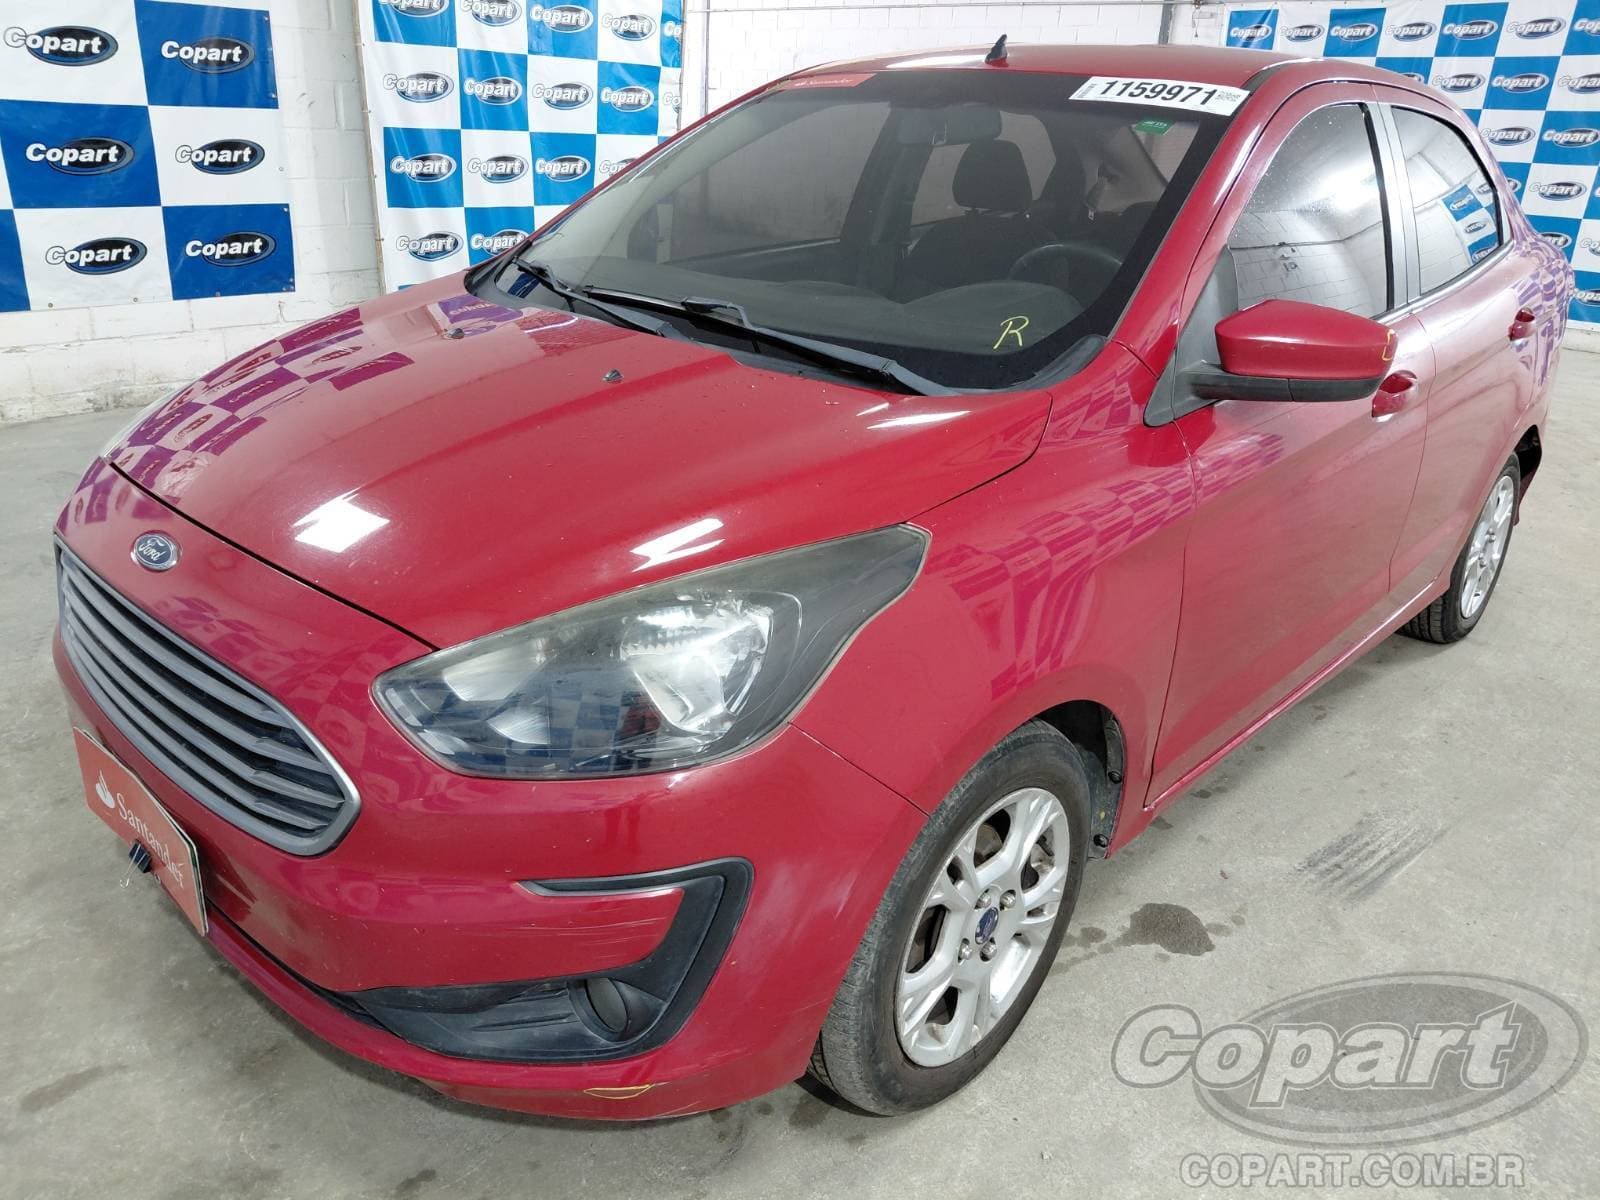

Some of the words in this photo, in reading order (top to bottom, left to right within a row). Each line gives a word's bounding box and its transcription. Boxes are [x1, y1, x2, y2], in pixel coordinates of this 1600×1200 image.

[461, 0, 513, 18] Copart
[530, 4, 587, 27] Copart
[602, 13, 649, 33] Copart
[1230, 26, 1267, 39] Copart
[1279, 26, 1319, 39] Copart
[1330, 25, 1372, 38] Copart
[1386, 23, 1428, 37] Copart
[1443, 22, 1491, 36] Copart
[1507, 19, 1557, 35] Copart
[4, 27, 102, 54] Copart
[161, 40, 243, 62] Copart
[383, 73, 446, 97] Copart
[464, 78, 516, 99] Copart
[1432, 75, 1478, 89] Copart
[1491, 75, 1542, 90] Copart
[532, 83, 587, 103] Copart
[601, 87, 649, 106] Copart
[1100, 80, 1218, 106] 1159971
[1480, 127, 1529, 141] Copart
[1541, 128, 1596, 143] Copart
[25, 143, 119, 166] Copart
[175, 144, 252, 165] Copart
[390, 155, 450, 178] Copart
[467, 157, 522, 177] Copart
[535, 158, 585, 176] Copart
[1529, 182, 1580, 198] Copart
[46, 244, 132, 266] Copart
[185, 238, 263, 259] Copart
[396, 235, 455, 255] Copart
[993, 315, 1029, 350] R
[138, 537, 168, 561] Ford
[116, 792, 185, 889] Santander
